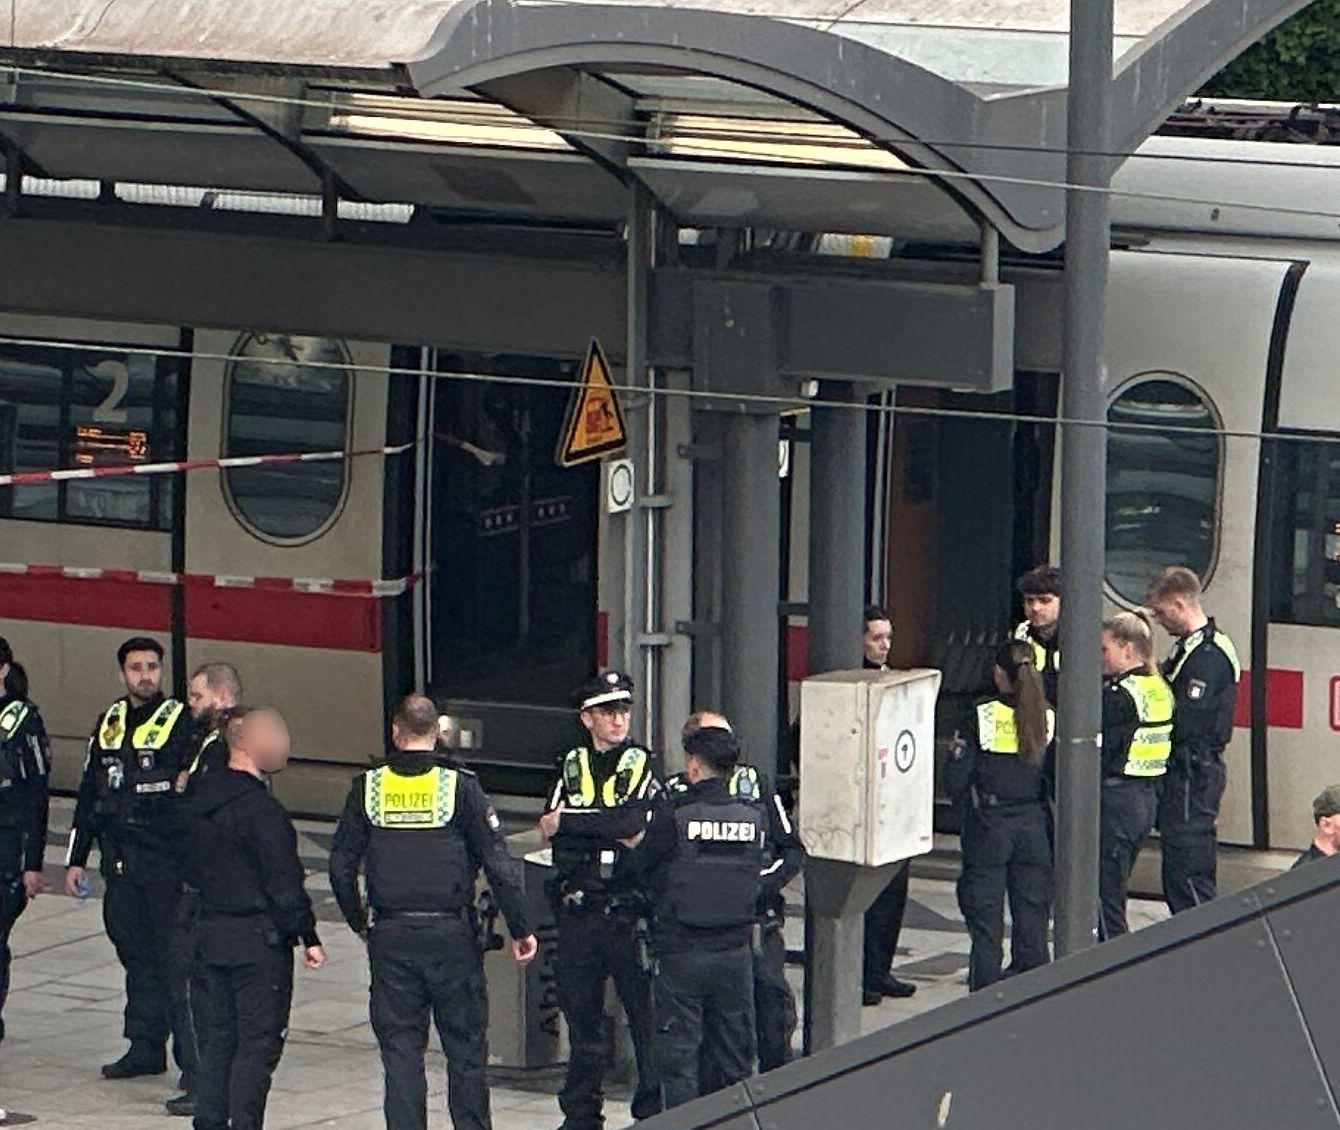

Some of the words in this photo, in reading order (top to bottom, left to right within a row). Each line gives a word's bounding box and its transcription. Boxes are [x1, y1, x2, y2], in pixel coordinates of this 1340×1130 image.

[83, 360, 129, 423] 2
[385, 793, 434, 809] POLIZEI
[687, 821, 756, 842] POLIZEI
